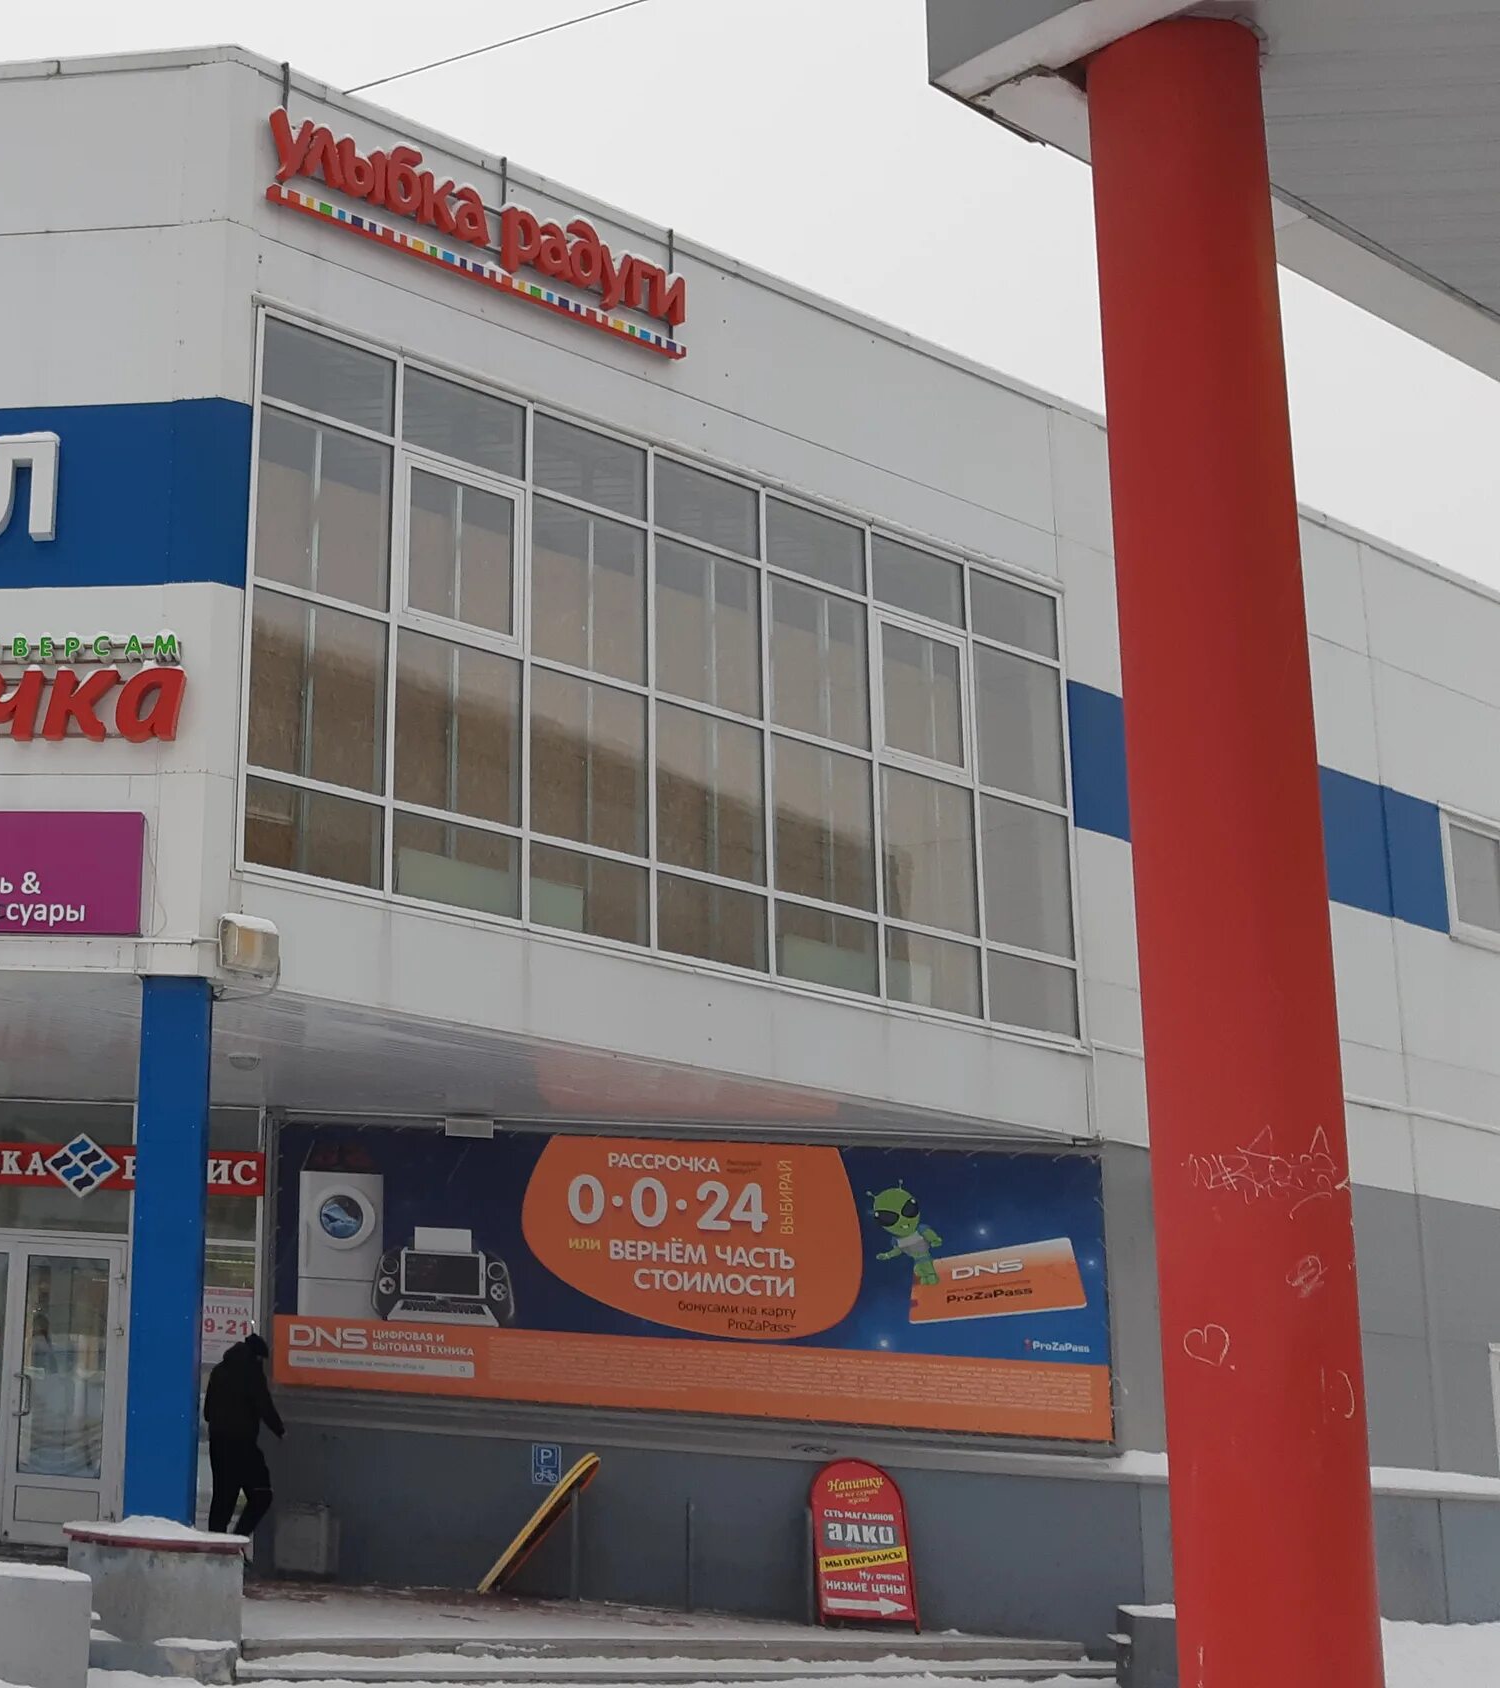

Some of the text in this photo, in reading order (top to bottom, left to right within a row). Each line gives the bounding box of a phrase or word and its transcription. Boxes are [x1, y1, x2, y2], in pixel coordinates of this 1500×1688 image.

[500, 203, 686, 326] радуги
[21, 871, 42, 895] &
[608, 1153, 720, 1173] РАССРОЧКА
[778, 1160, 794, 1235] ВЫБИРАЙ
[609, 1238, 707, 1264] ВЕРНЁМ
[716, 1246, 795, 1270] ЧАСТЬ
[952, 1259, 1024, 1280] DNS
[634, 1269, 795, 1297] СТОИМОСТИ
[946, 1286, 1033, 1304] ProZaPass
[204, 1305, 249, 1316] АПТЕКА
[678, 1302, 797, 1320] бонусами на карту
[289, 1324, 368, 1349] DNS
[372, 1329, 445, 1342] ЦИФРОВАЯ И
[372, 1343, 475, 1356] БЫТОВАЯ ТЕХНИКА
[827, 1477, 884, 1493] Напитки
[824, 1509, 895, 1521] СЕТЬ МАГАЗИНОВ
[825, 1552, 903, 1569] МЫ ОТКРЫЛИСЬ!
[826, 1580, 907, 1595] НИЗКИЕ ЦЕНЫ!
